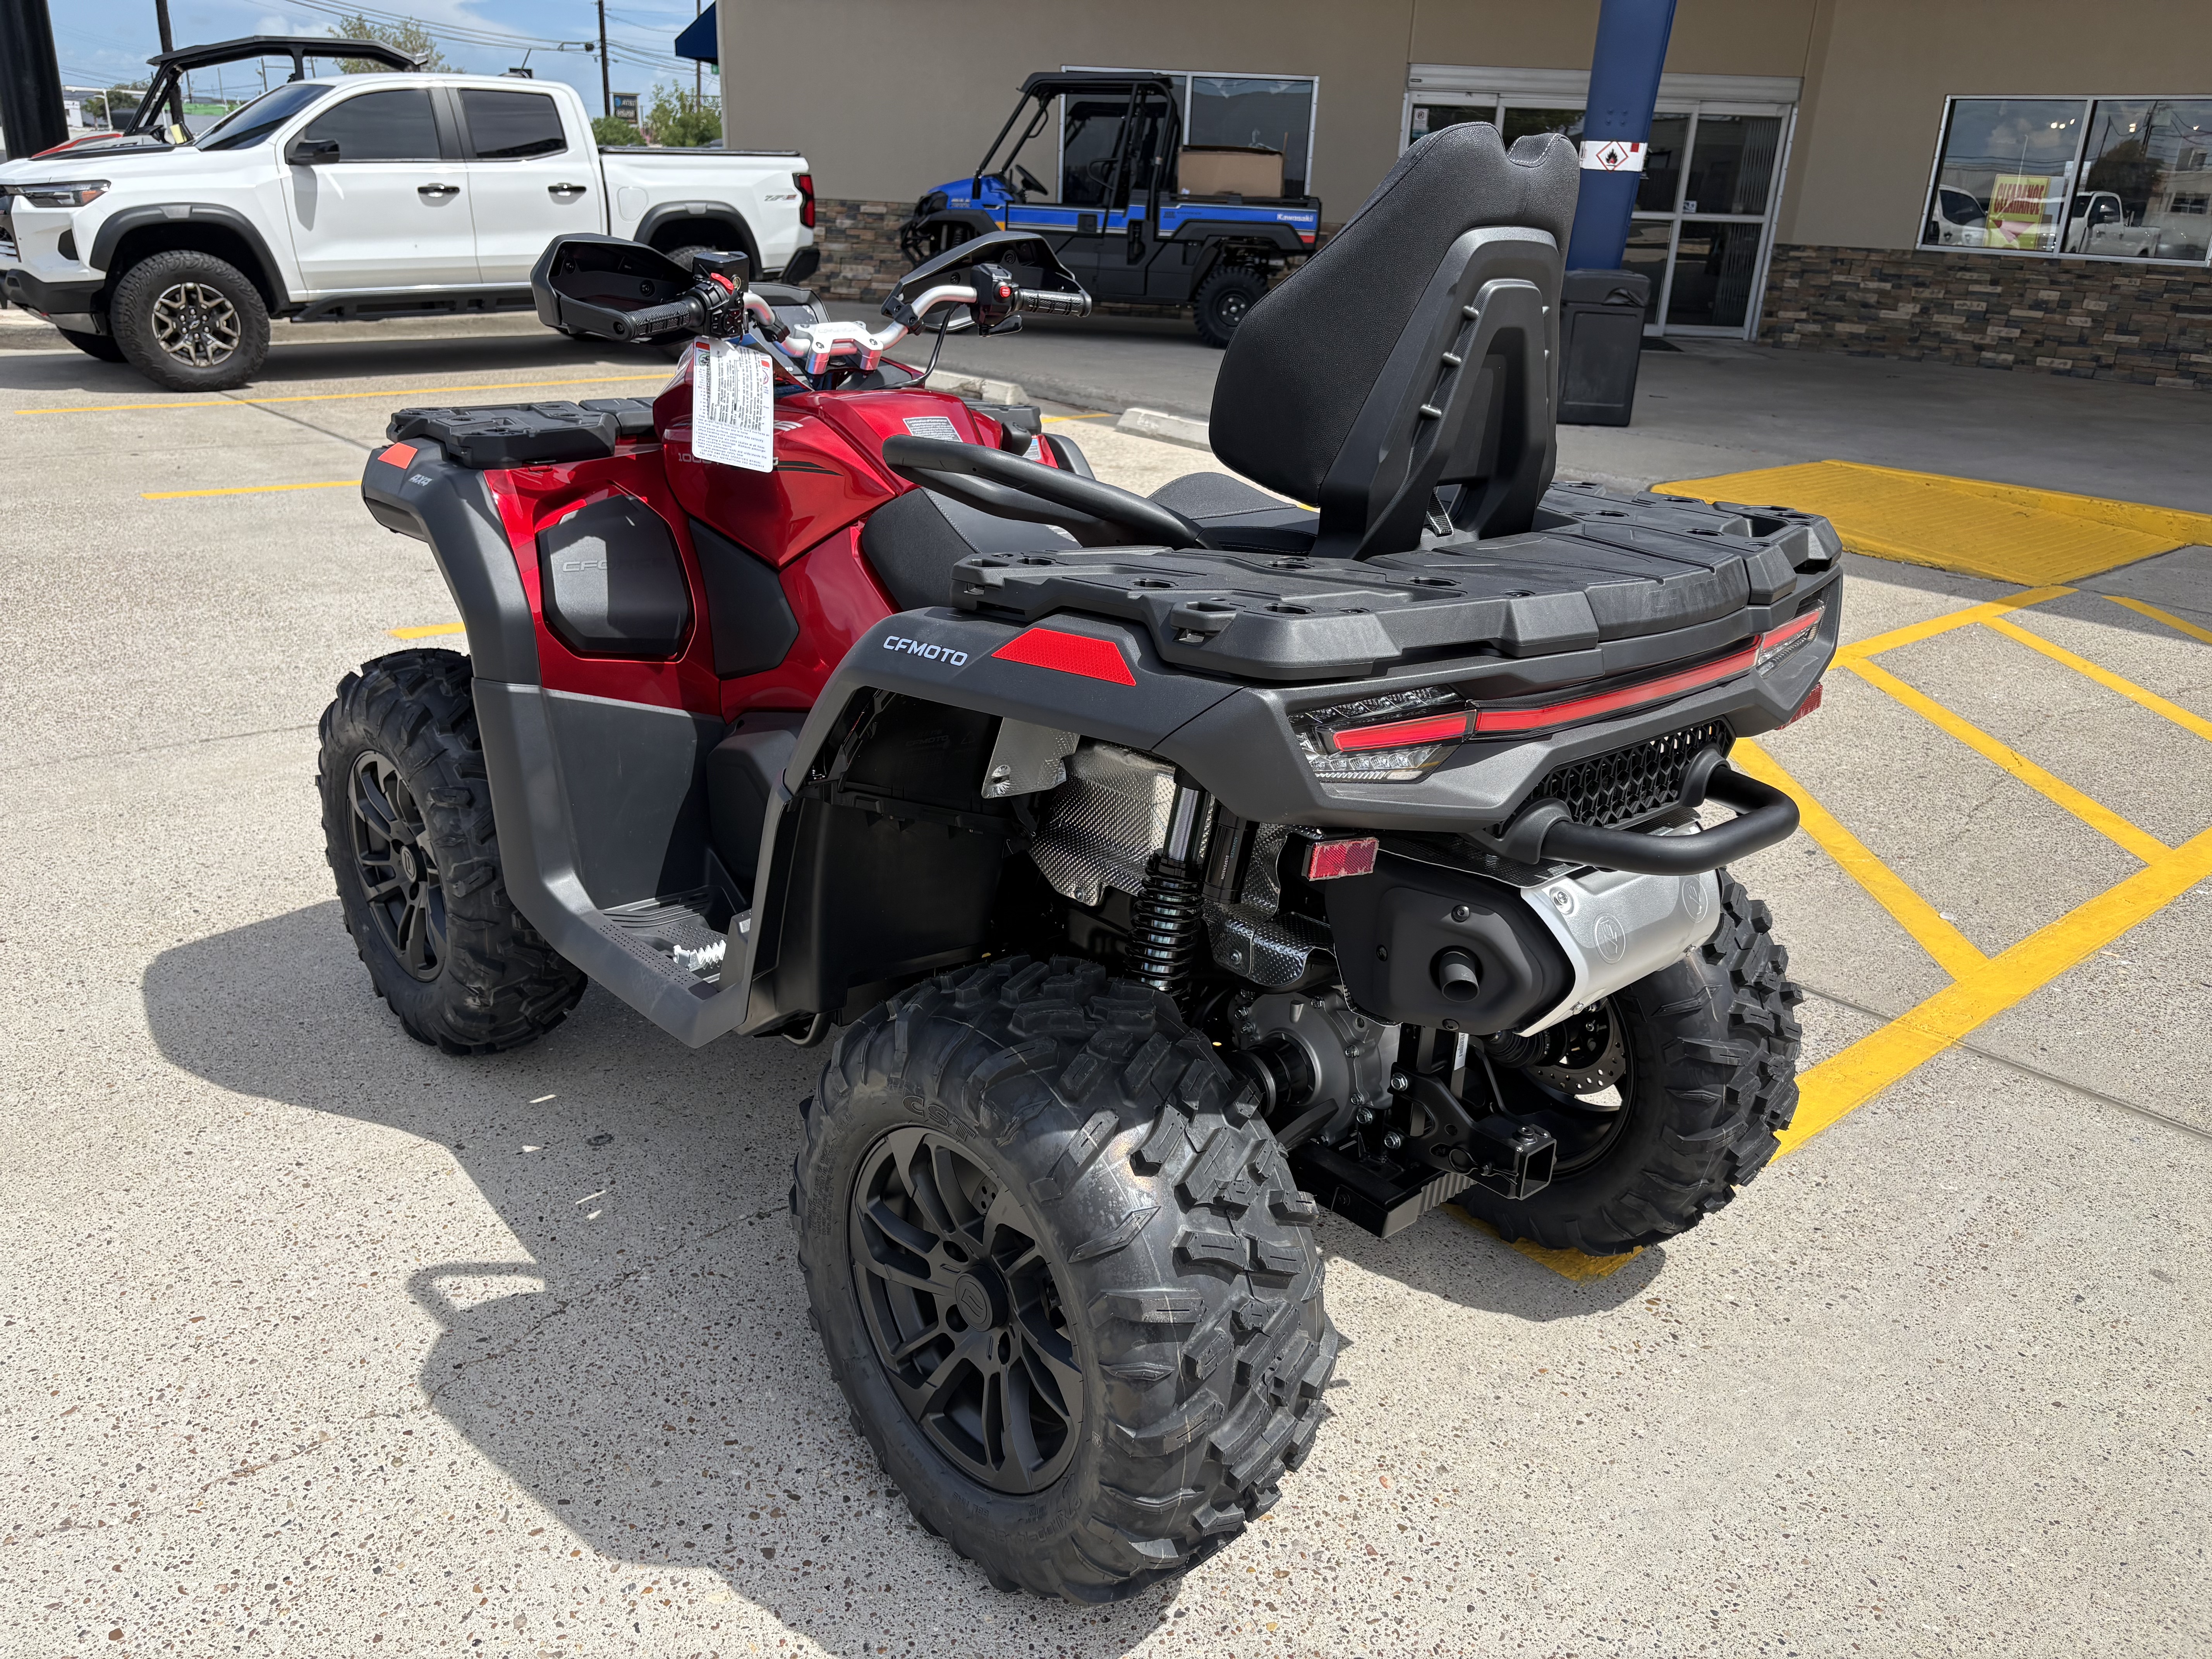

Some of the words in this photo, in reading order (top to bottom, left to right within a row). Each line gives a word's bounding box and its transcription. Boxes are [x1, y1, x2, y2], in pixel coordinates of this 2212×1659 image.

[1994, 182, 2045, 215] CLEARANCE
[1277, 214, 1314, 222] Kawasaki
[409, 474, 432, 486] 4X4
[883, 635, 968, 666] CFMOTO
[1221, 855, 1230, 880] SUSPENSION
[903, 1095, 976, 1142] CST
